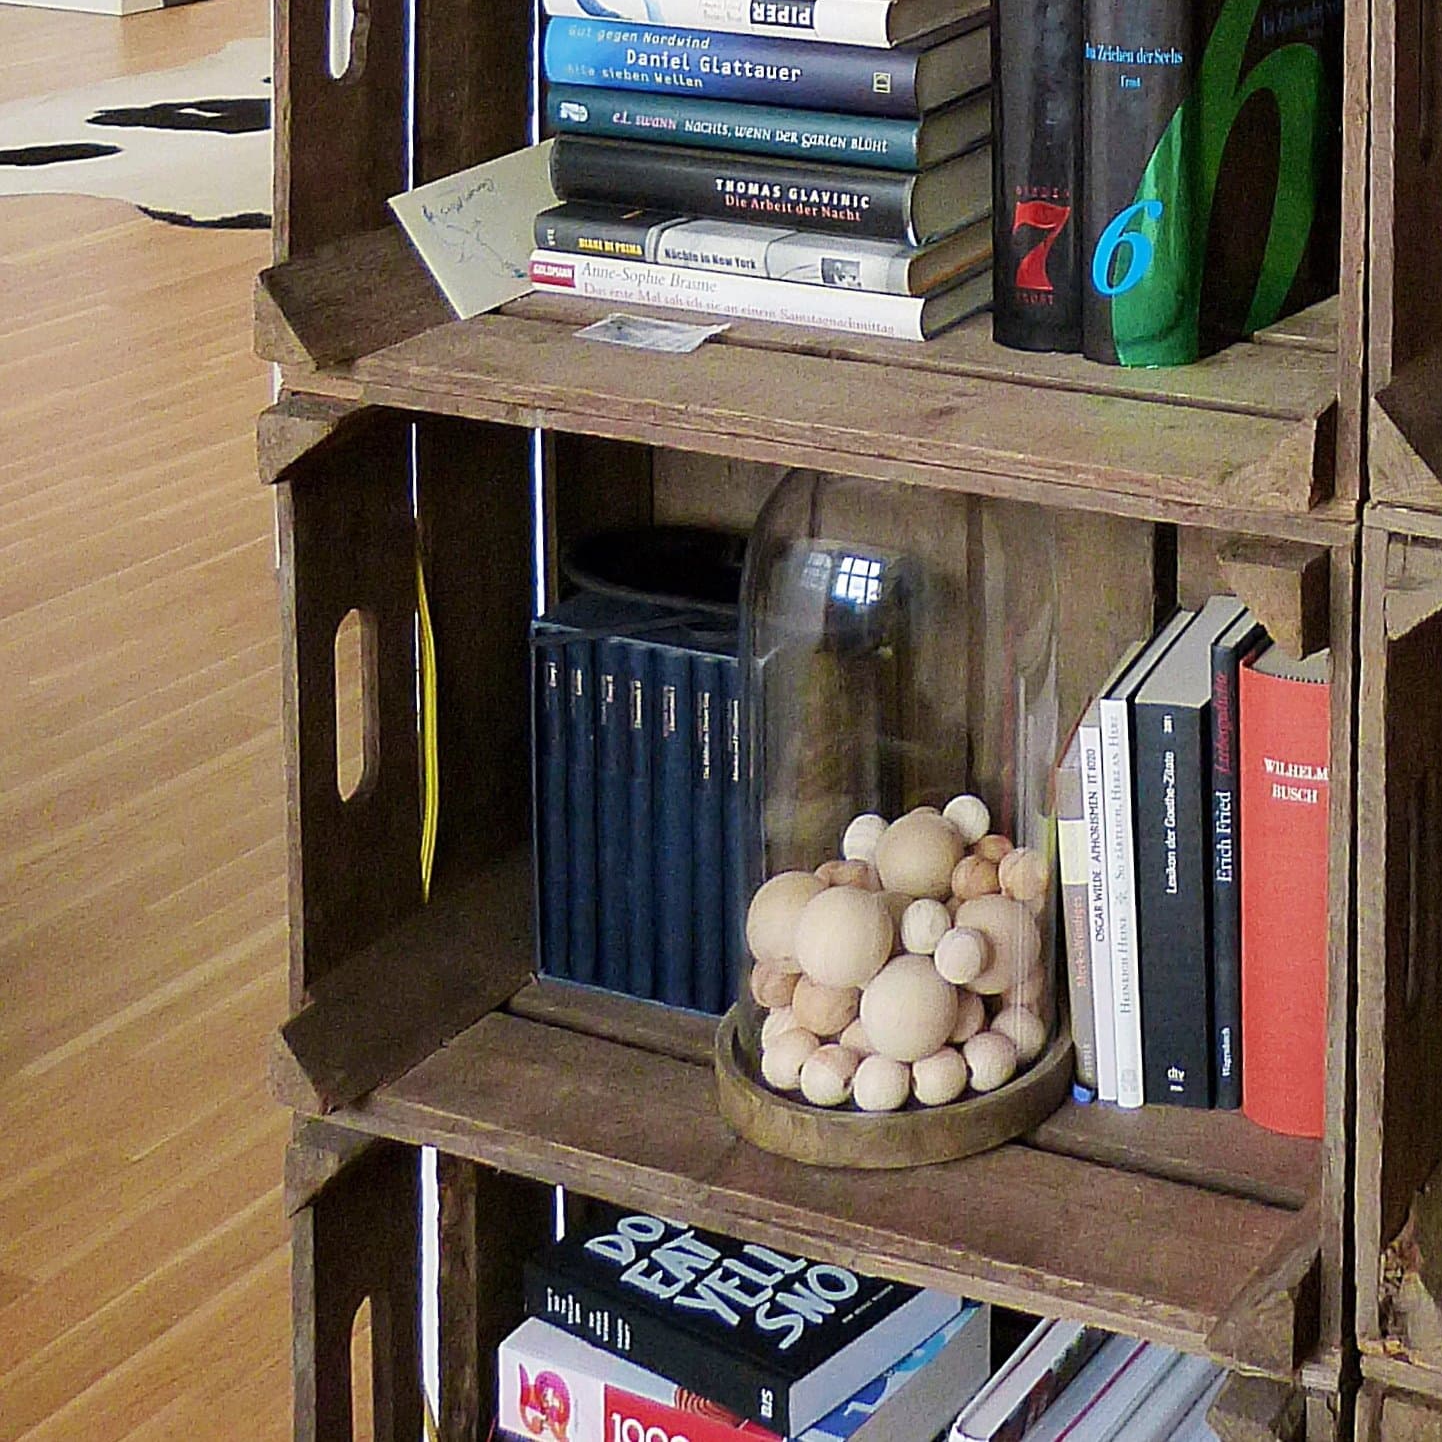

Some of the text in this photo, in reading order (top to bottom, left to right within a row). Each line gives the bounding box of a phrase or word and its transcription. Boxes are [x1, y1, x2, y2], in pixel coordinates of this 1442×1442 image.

[751, 2, 811, 25] PIPER
[597, 28, 711, 49] gegen Nordwind
[626, 48, 802, 83] Daniel Glattauer
[1136, 46, 1154, 64] der
[715, 178, 871, 209] THOMAS GLAVINIC
[725, 195, 862, 222] Die Arbeit der Nacht
[1013, 200, 1071, 291] 7
[1092, 199, 1164, 296] 6
[582, 262, 666, 288] Anne-Sophie
[712, 254, 757, 270] New York
[584, 283, 606, 296] Das
[1263, 757, 1329, 803] WILHELM BUSCH
[1087, 790, 1102, 863] APHORISMEN
[1164, 830, 1177, 849] der
[1214, 790, 1233, 883] Erich Fried
[1090, 870, 1104, 903] WILDE
[1164, 851, 1179, 894] Lexikon
[1091, 905, 1106, 943] OSCAR
[1166, 1066, 1185, 1081] dtv
[620, 1229, 721, 1300] EAT
